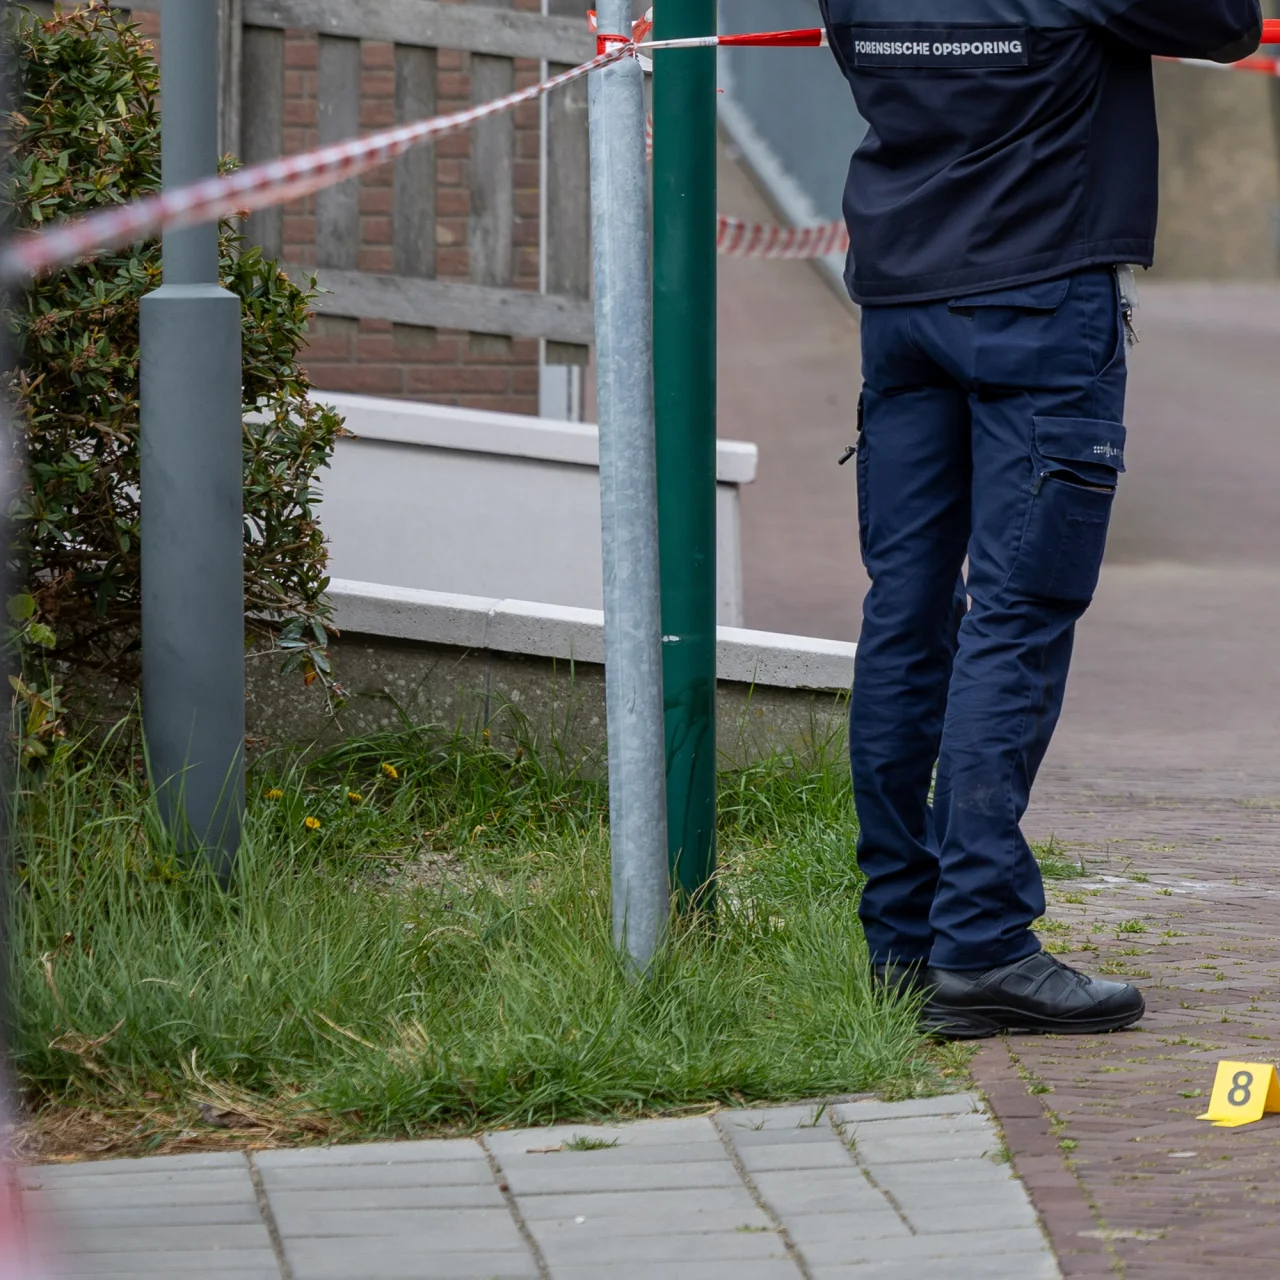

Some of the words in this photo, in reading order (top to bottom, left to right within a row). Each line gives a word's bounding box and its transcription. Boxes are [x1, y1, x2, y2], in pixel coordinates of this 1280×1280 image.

[855, 41, 930, 55] FORENSISCHE
[932, 41, 1022, 55] OPSPORING
[1227, 1070, 1253, 1107] 8
